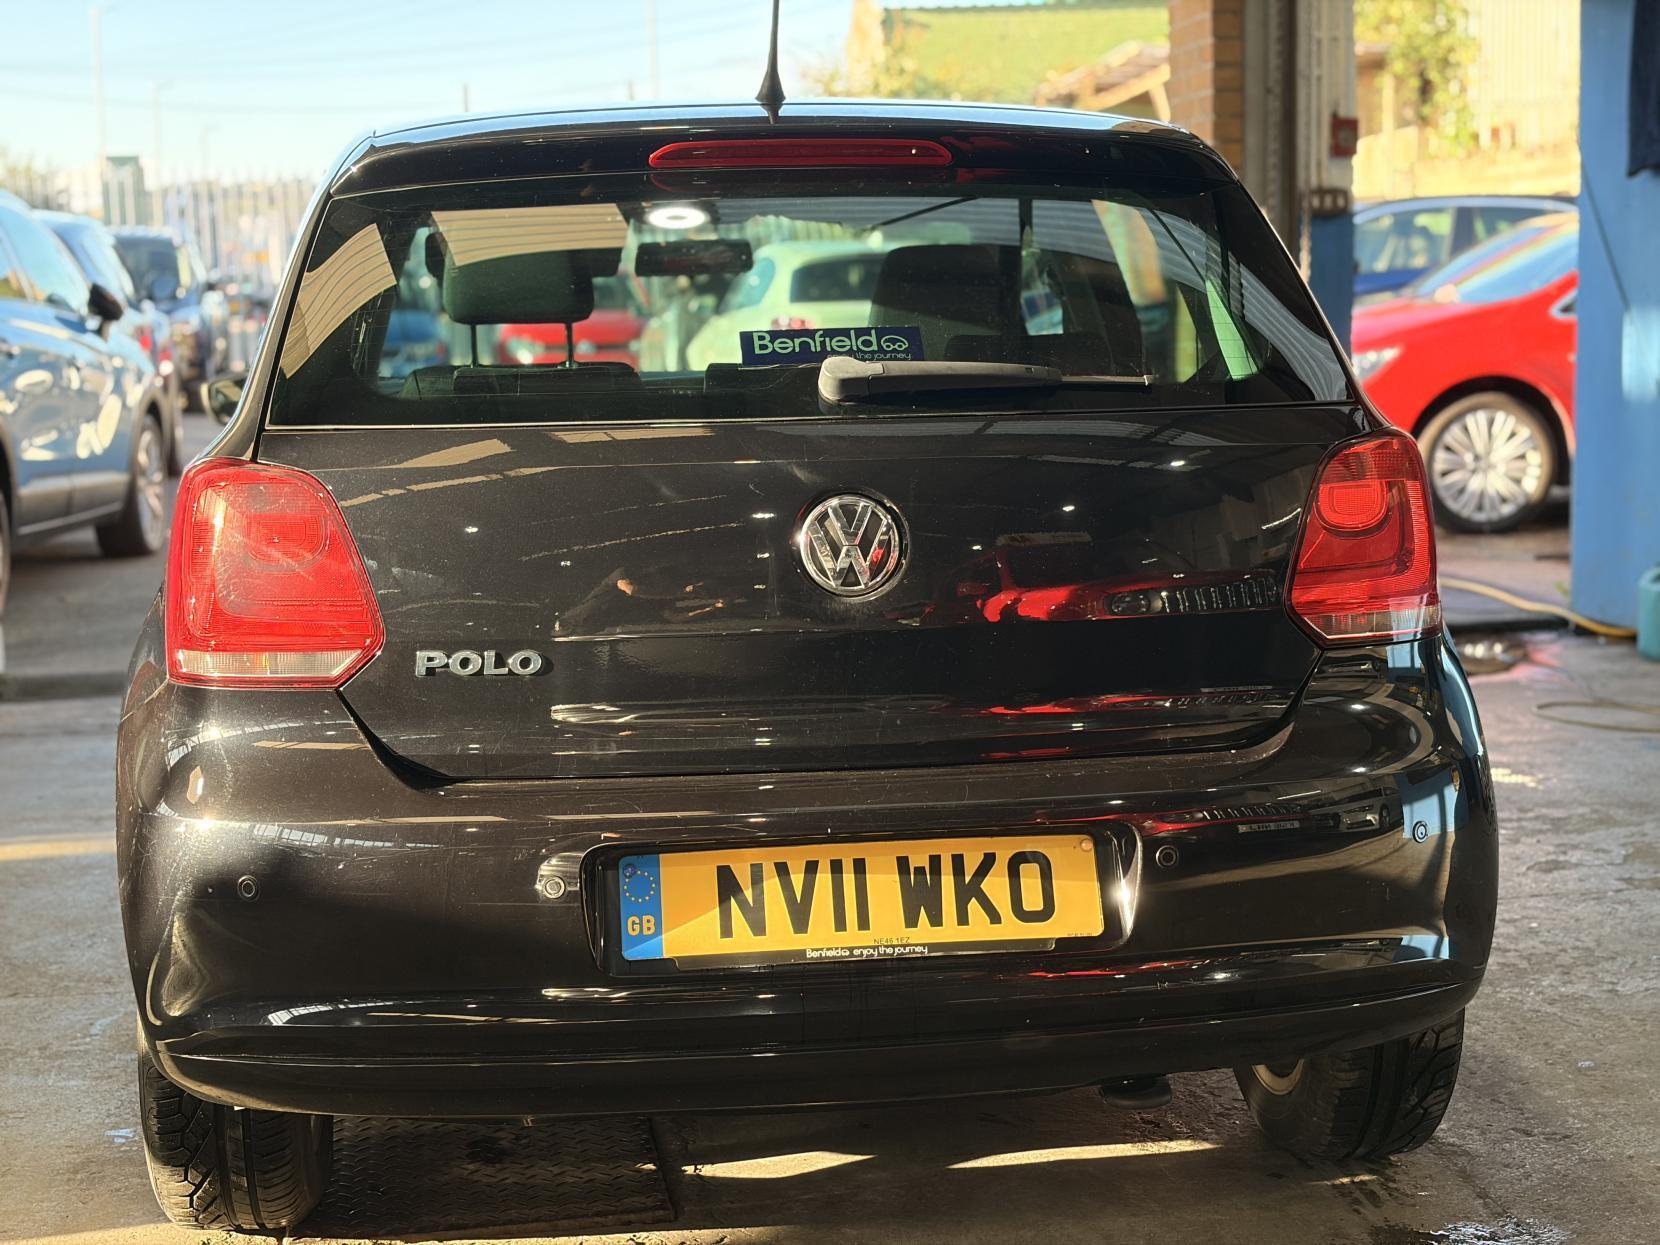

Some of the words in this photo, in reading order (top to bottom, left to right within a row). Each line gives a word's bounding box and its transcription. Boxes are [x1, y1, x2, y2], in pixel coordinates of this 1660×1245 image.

[752, 329, 877, 354] Benfield
[873, 352, 912, 361] journey
[415, 649, 543, 677] POLO
[715, 857, 870, 940] NV11
[895, 850, 1056, 930] WKO
[627, 915, 656, 936] GB
[806, 948, 841, 958] Benfield
[853, 948, 878, 958] enjoy
[878, 946, 893, 954] the
[894, 946, 928, 956] journey
